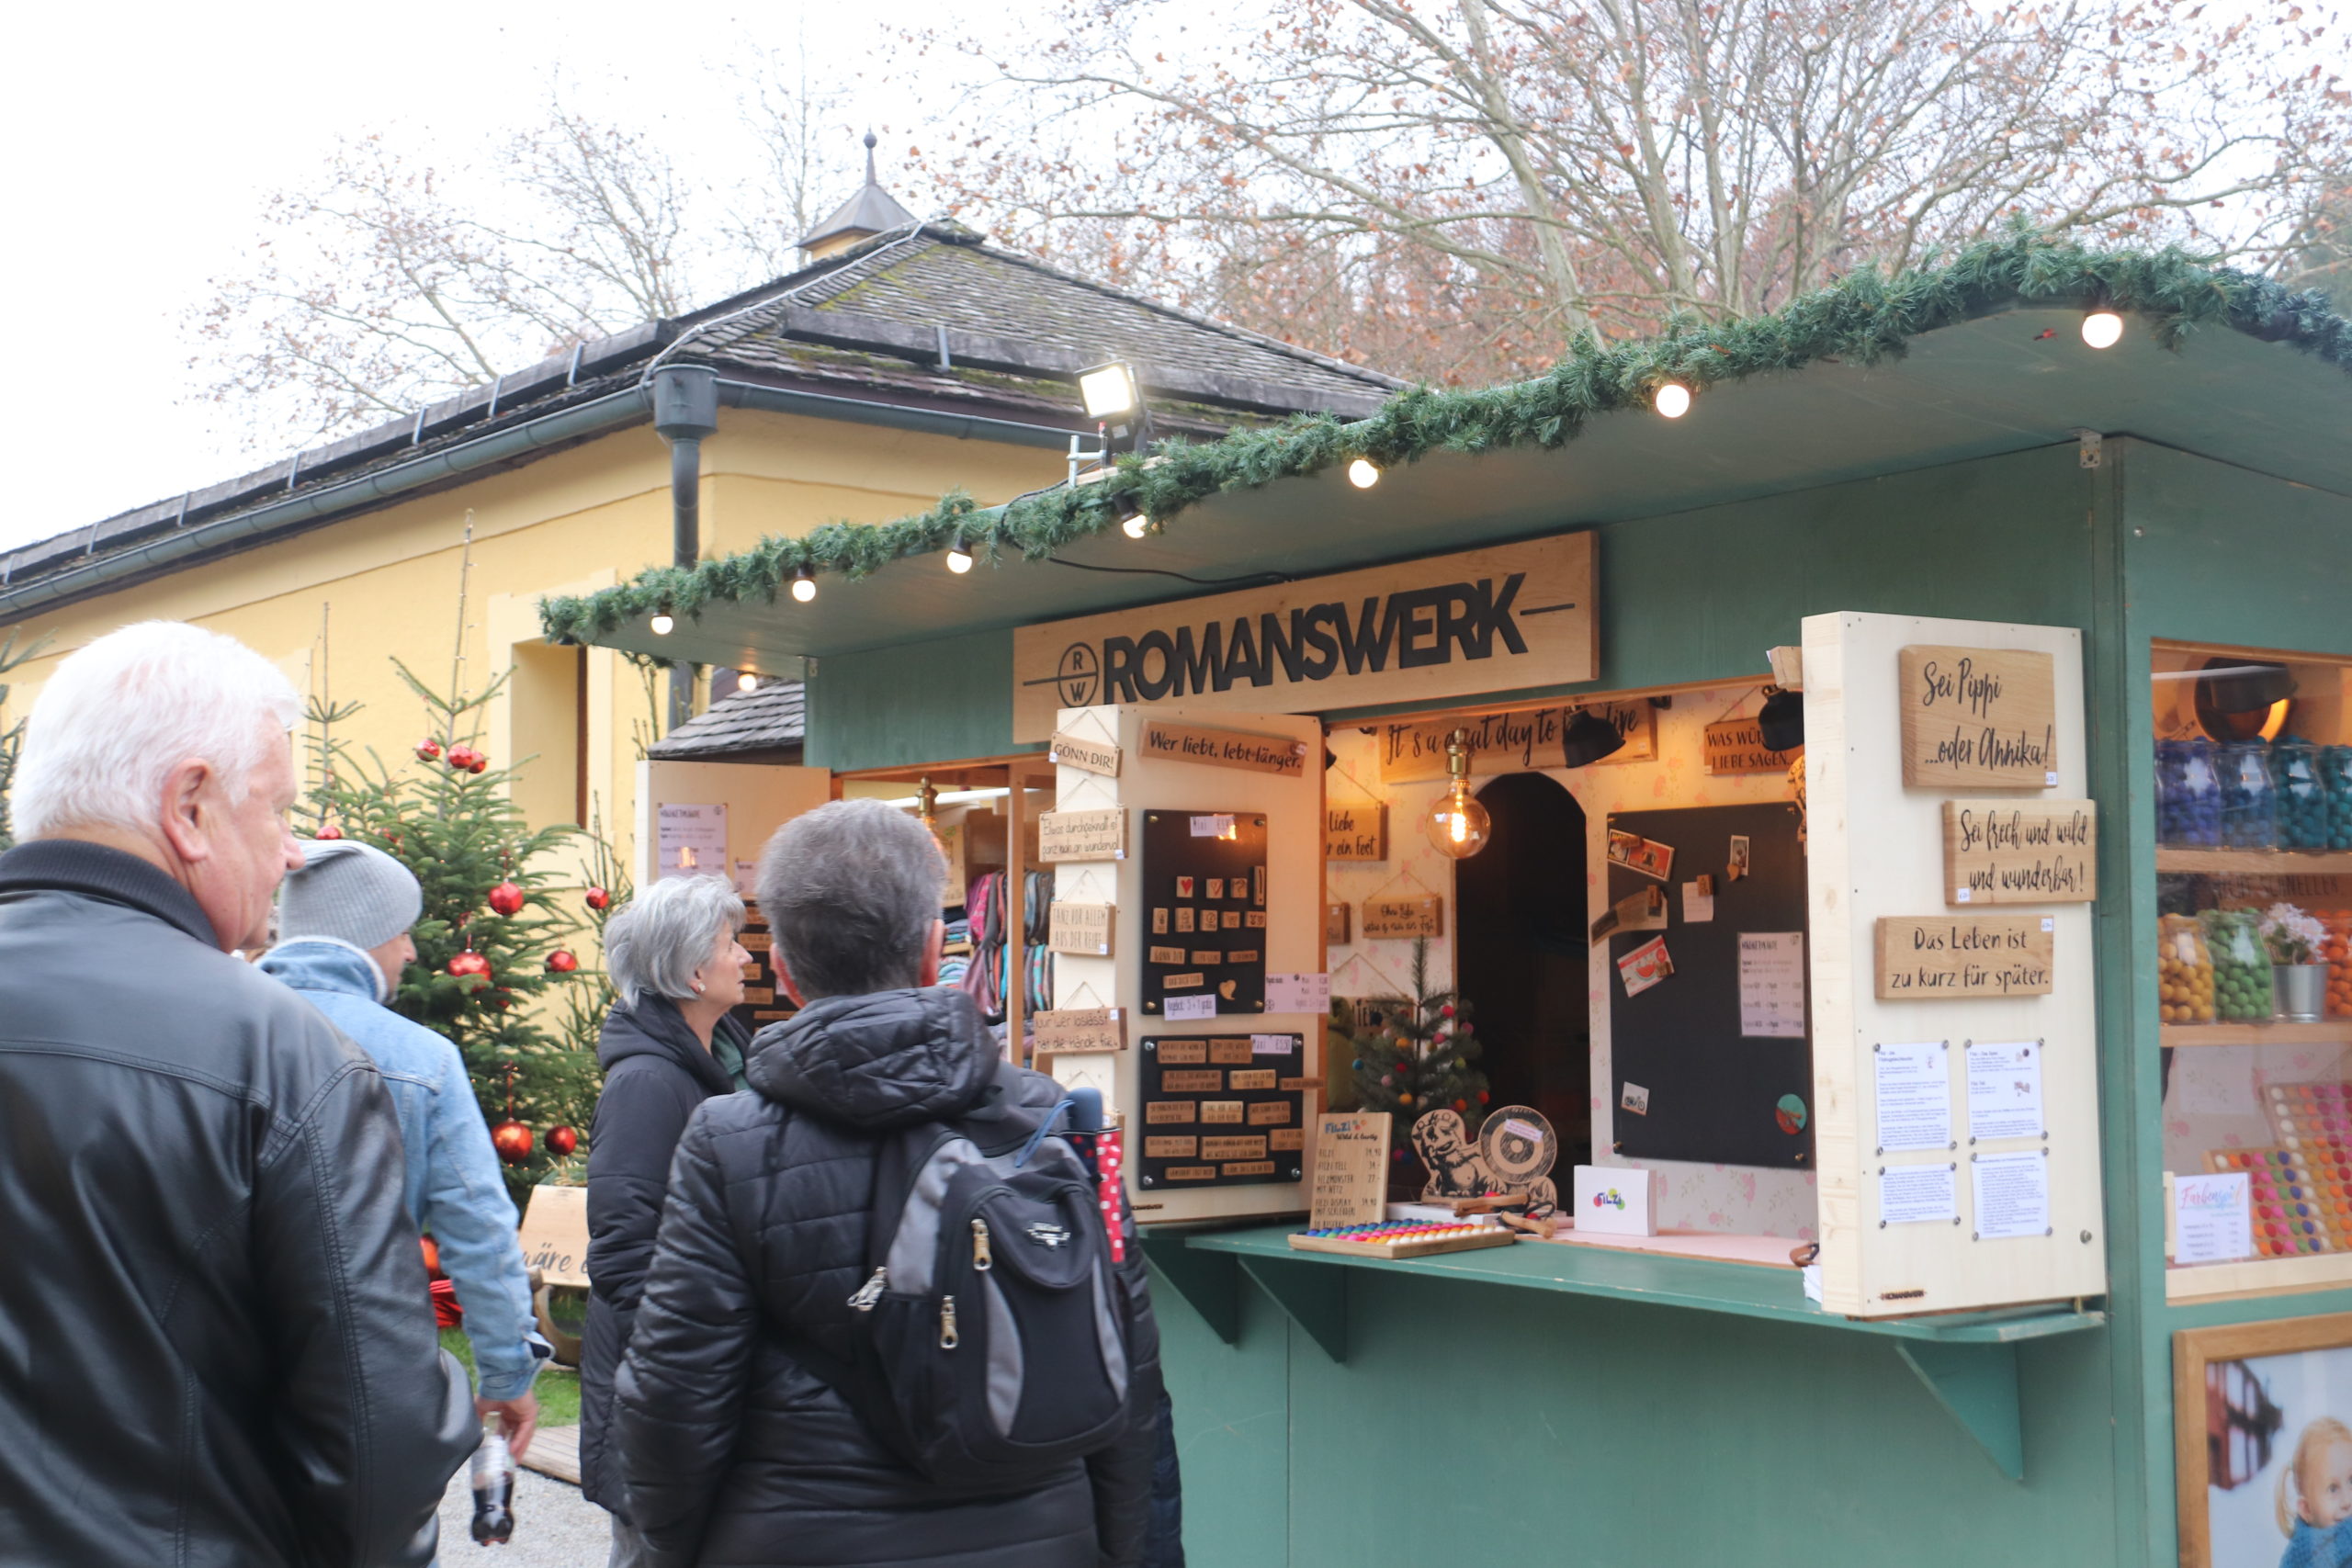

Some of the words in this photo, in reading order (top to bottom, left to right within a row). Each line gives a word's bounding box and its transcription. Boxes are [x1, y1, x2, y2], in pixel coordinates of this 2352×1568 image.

[1102, 572, 1526, 705] ROMANSWERK
[1072, 650, 1083, 671] R
[1069, 682, 1086, 702] W
[1923, 660, 1955, 706] Sei
[1957, 657, 2001, 718] Pippi
[1496, 712, 1533, 766] day
[1535, 708, 1557, 741] to
[1707, 732, 1733, 747] WAS
[1979, 724, 2052, 770] Annika!
[1054, 742, 1089, 763] GÖNN
[1091, 752, 1114, 770] DIR!
[1150, 731, 1177, 751] Wer
[1182, 735, 1217, 759] liebt,
[1224, 740, 1253, 761] lebt
[1254, 746, 1301, 772] länger.
[1713, 753, 1745, 769] LIEBE
[1329, 810, 1354, 832] Liebe
[1961, 809, 1983, 852] Sei
[1985, 810, 2021, 852] frech
[2026, 809, 2052, 846] und
[2056, 809, 2087, 846] wild
[1336, 839, 1351, 855] ein
[1356, 835, 1376, 855] Fest
[1969, 858, 1996, 891] und
[1053, 908, 1070, 926] TANZ
[1071, 908, 1083, 926] VOR
[1085, 908, 1106, 927] ALLEM
[1055, 931, 1068, 949] AUS
[1069, 931, 1082, 949] DER
[1913, 926, 1944, 950] Das
[1951, 926, 2001, 950] Leben
[2007, 927, 2028, 949] ist
[1891, 970, 1911, 989] zu
[1918, 965, 1956, 987] kurz
[1963, 964, 1989, 986] für
[1995, 964, 2049, 993] später.
